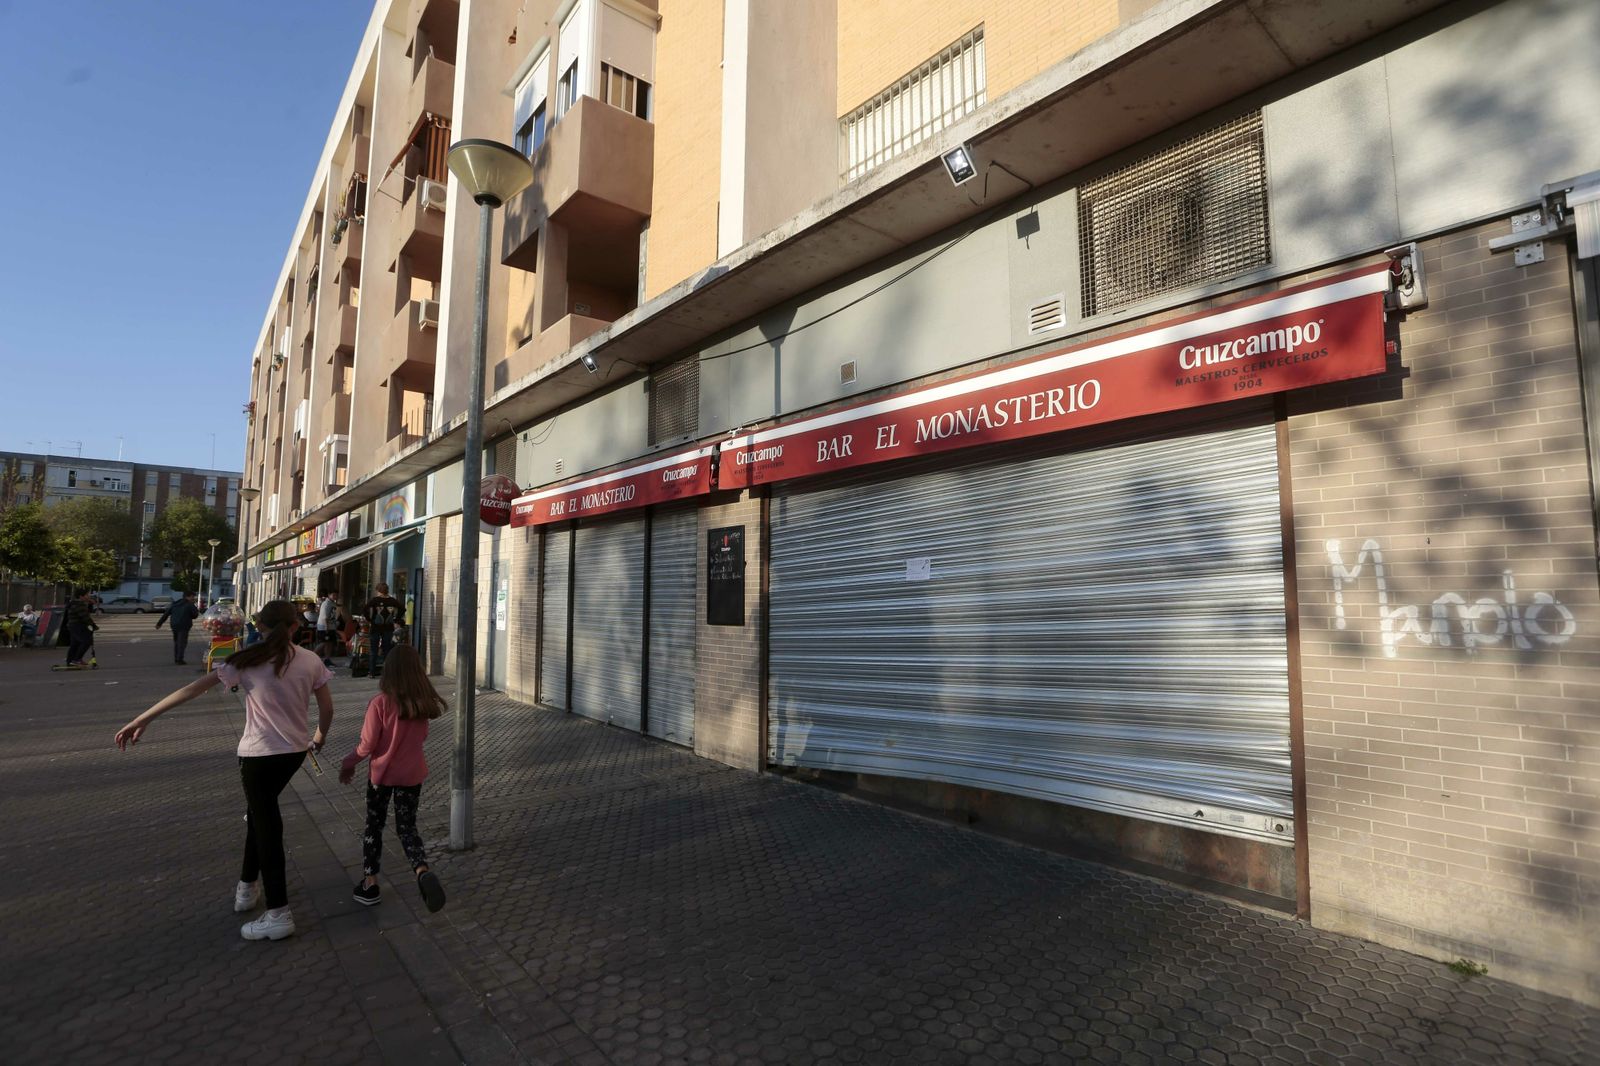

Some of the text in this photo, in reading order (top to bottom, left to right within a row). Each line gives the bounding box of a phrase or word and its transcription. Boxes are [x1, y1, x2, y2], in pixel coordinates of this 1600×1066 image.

[1179, 321, 1322, 370] Cruzcampo
[1175, 347, 1329, 387] MAESTROS CERVECEROS
[1233, 378, 1263, 392] 1904
[817, 379, 1102, 463] BAR EL MONASTERIO
[736, 445, 783, 465] Cruzcampo
[663, 465, 698, 482] Cruzcampo
[480, 497, 511, 511] ruzcam
[550, 484, 635, 516] BAR EL MONASTERIO
